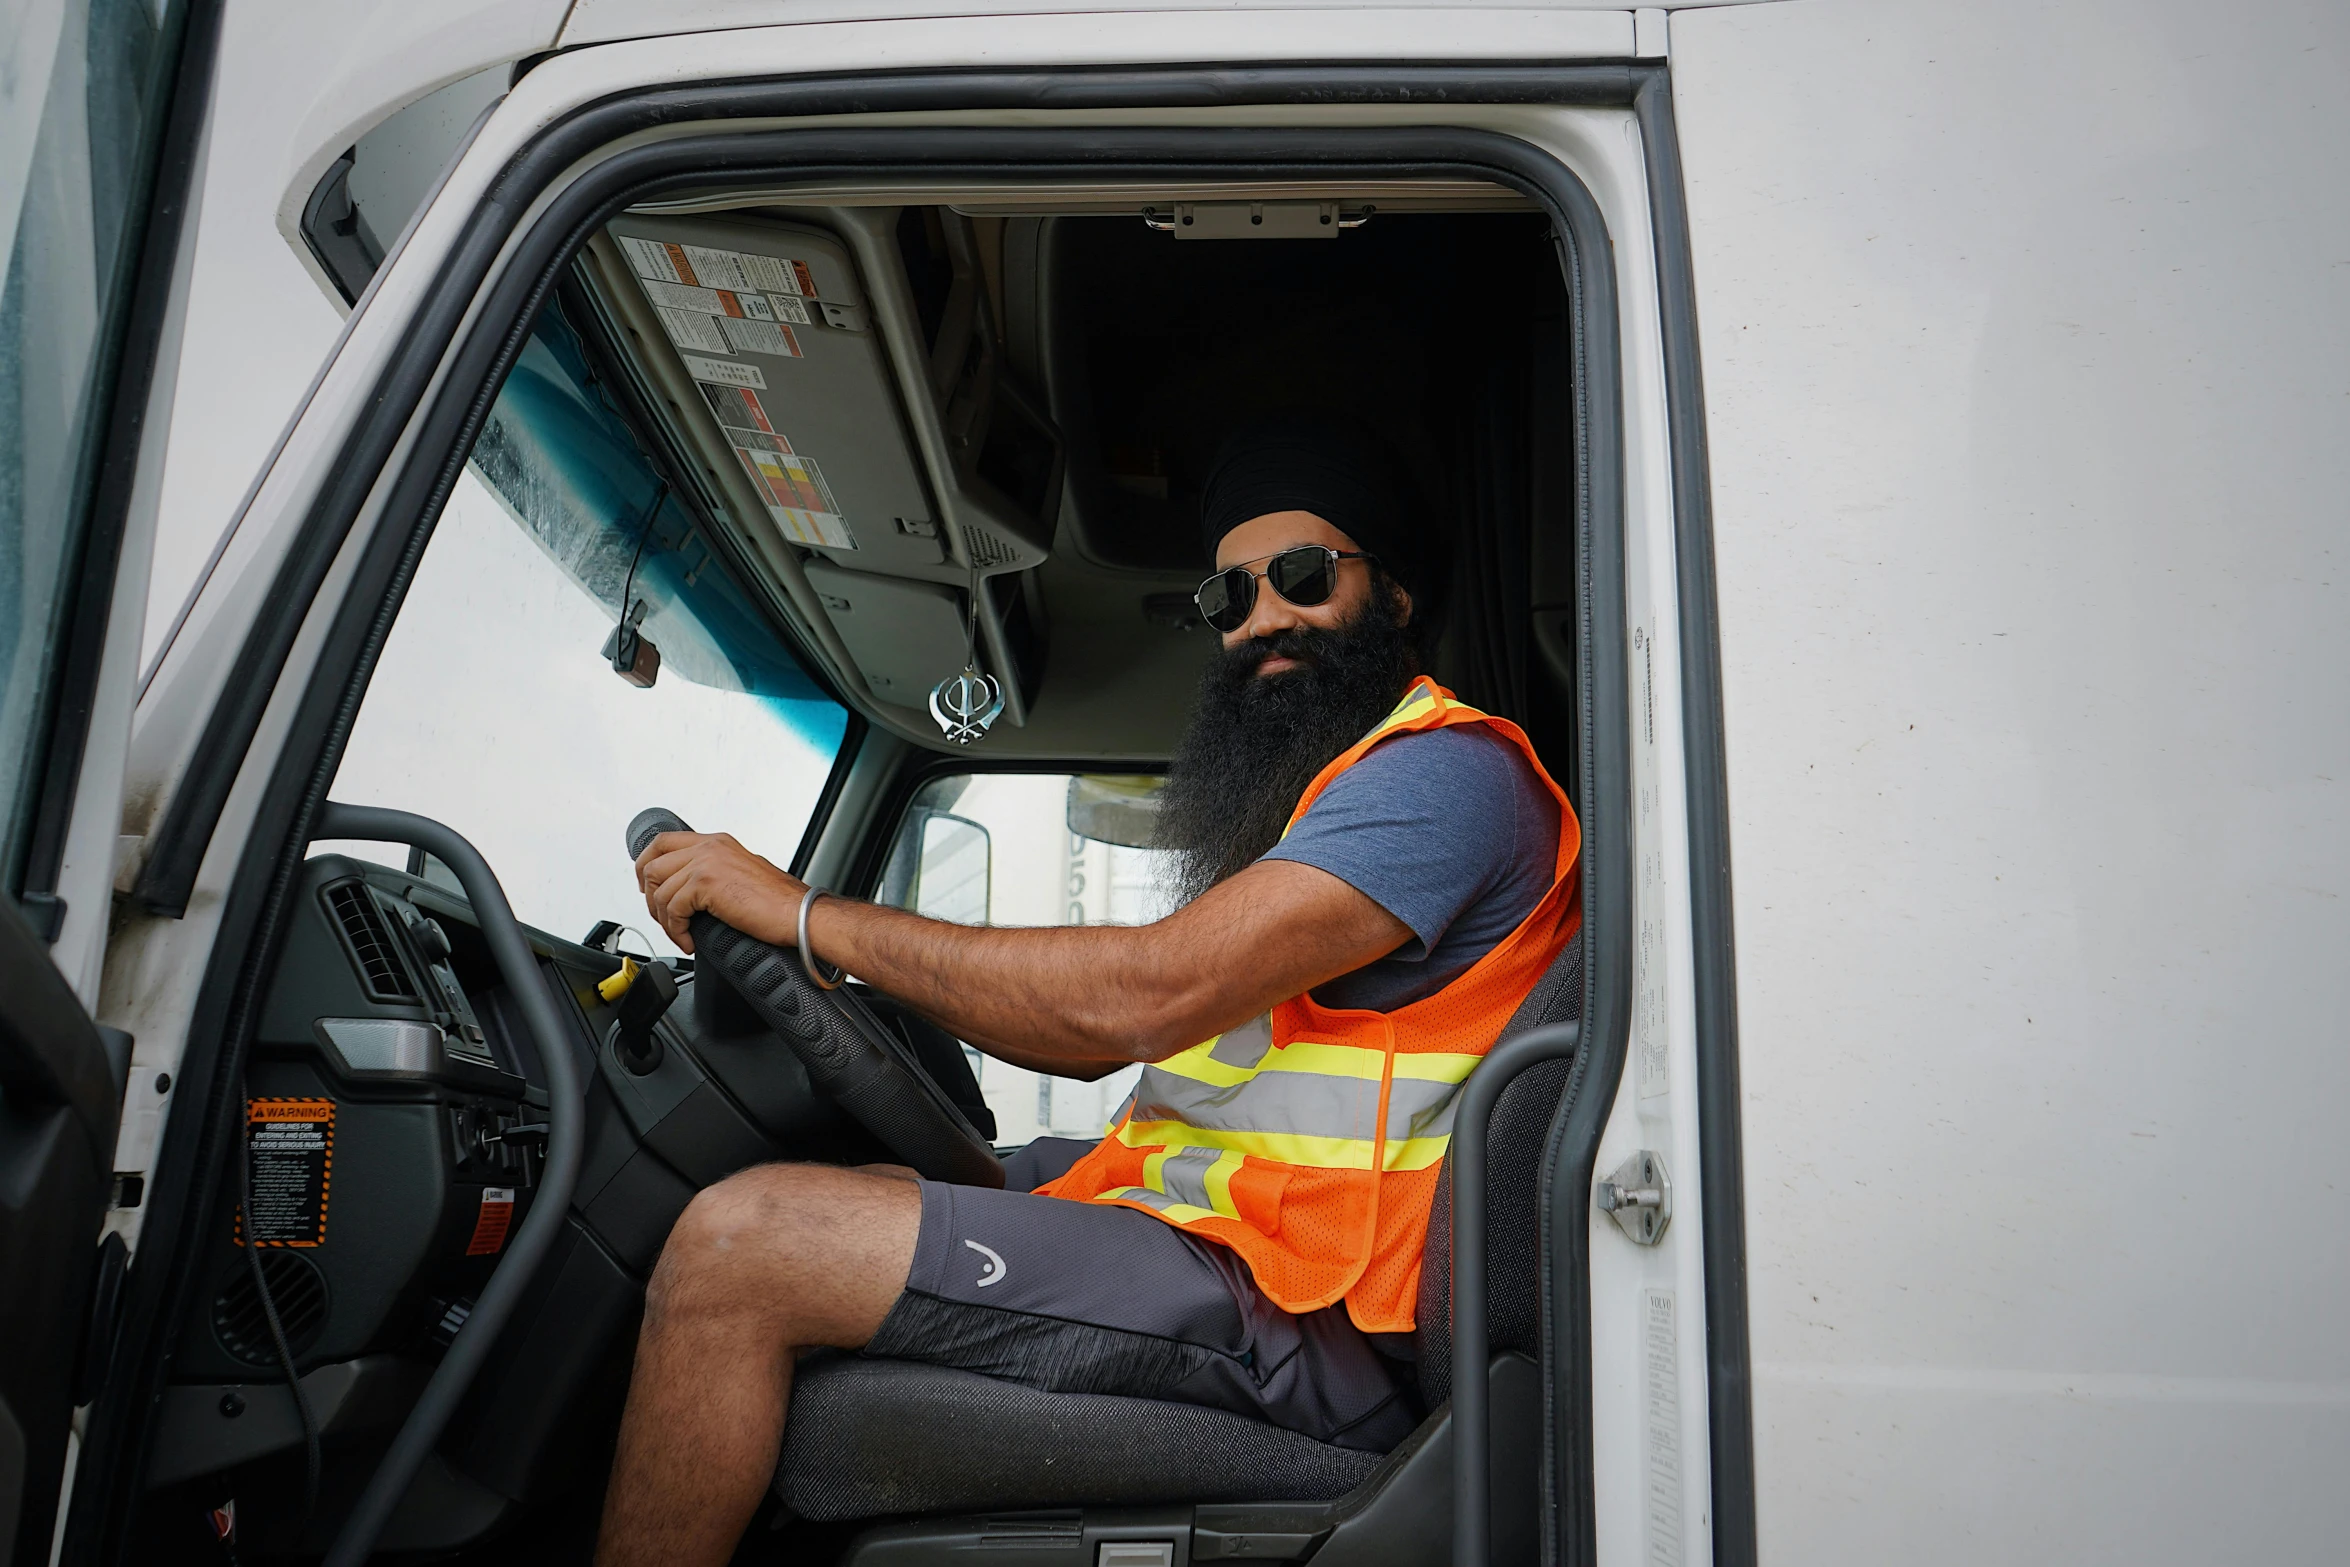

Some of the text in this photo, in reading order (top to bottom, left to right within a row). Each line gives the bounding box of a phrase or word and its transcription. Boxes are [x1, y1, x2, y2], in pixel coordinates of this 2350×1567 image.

[671, 252, 696, 285] WARNING
[266, 1107, 327, 1118] WARNING
[1650, 1295, 1672, 1310] VOLVO
